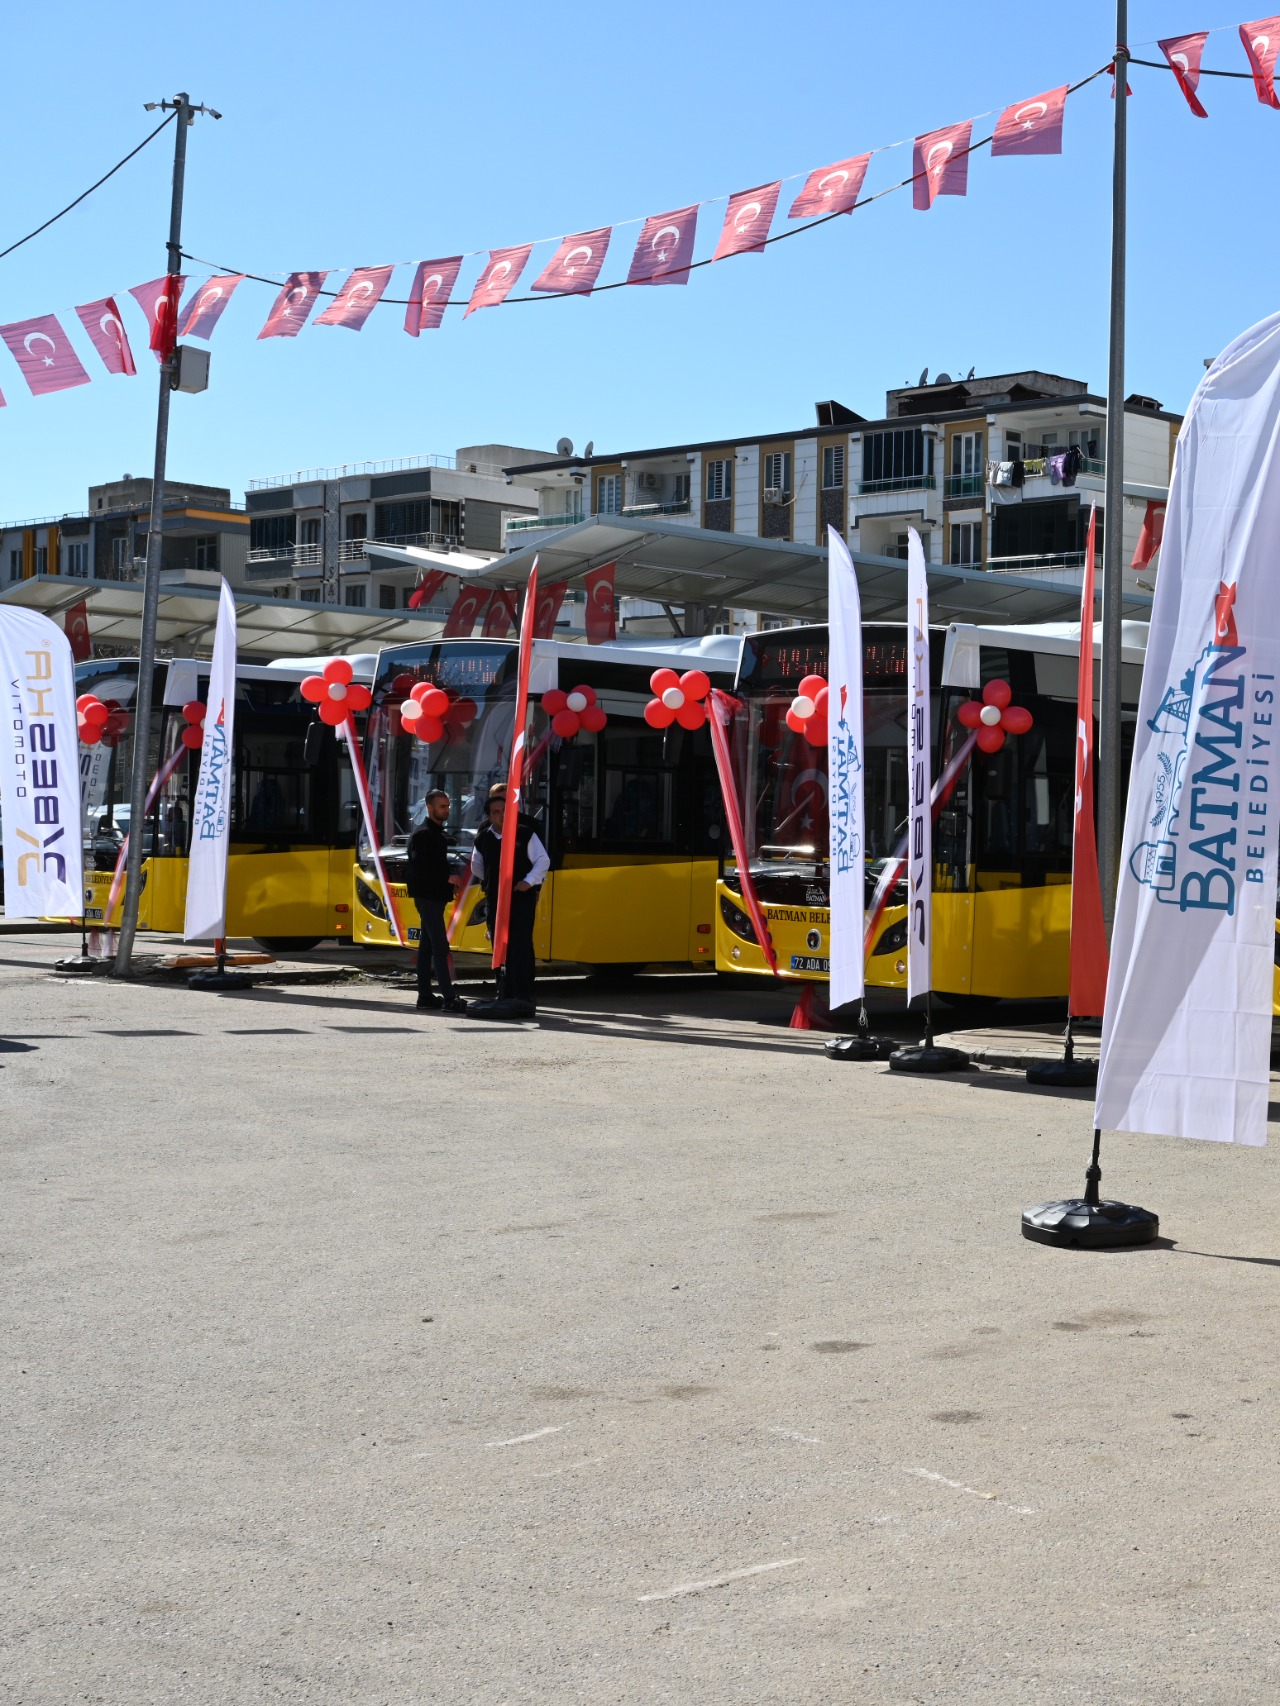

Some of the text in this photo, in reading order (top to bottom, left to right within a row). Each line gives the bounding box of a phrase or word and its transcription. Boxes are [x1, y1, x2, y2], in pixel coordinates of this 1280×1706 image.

[1154, 774, 1166, 804] 1955
[1179, 645, 1247, 916] BATMAN
[1245, 673, 1275, 884] BELEDİYESİ
[767, 908, 807, 923] BATMAN
[795, 958, 804, 968] 72
[806, 959, 820, 970] ADA
